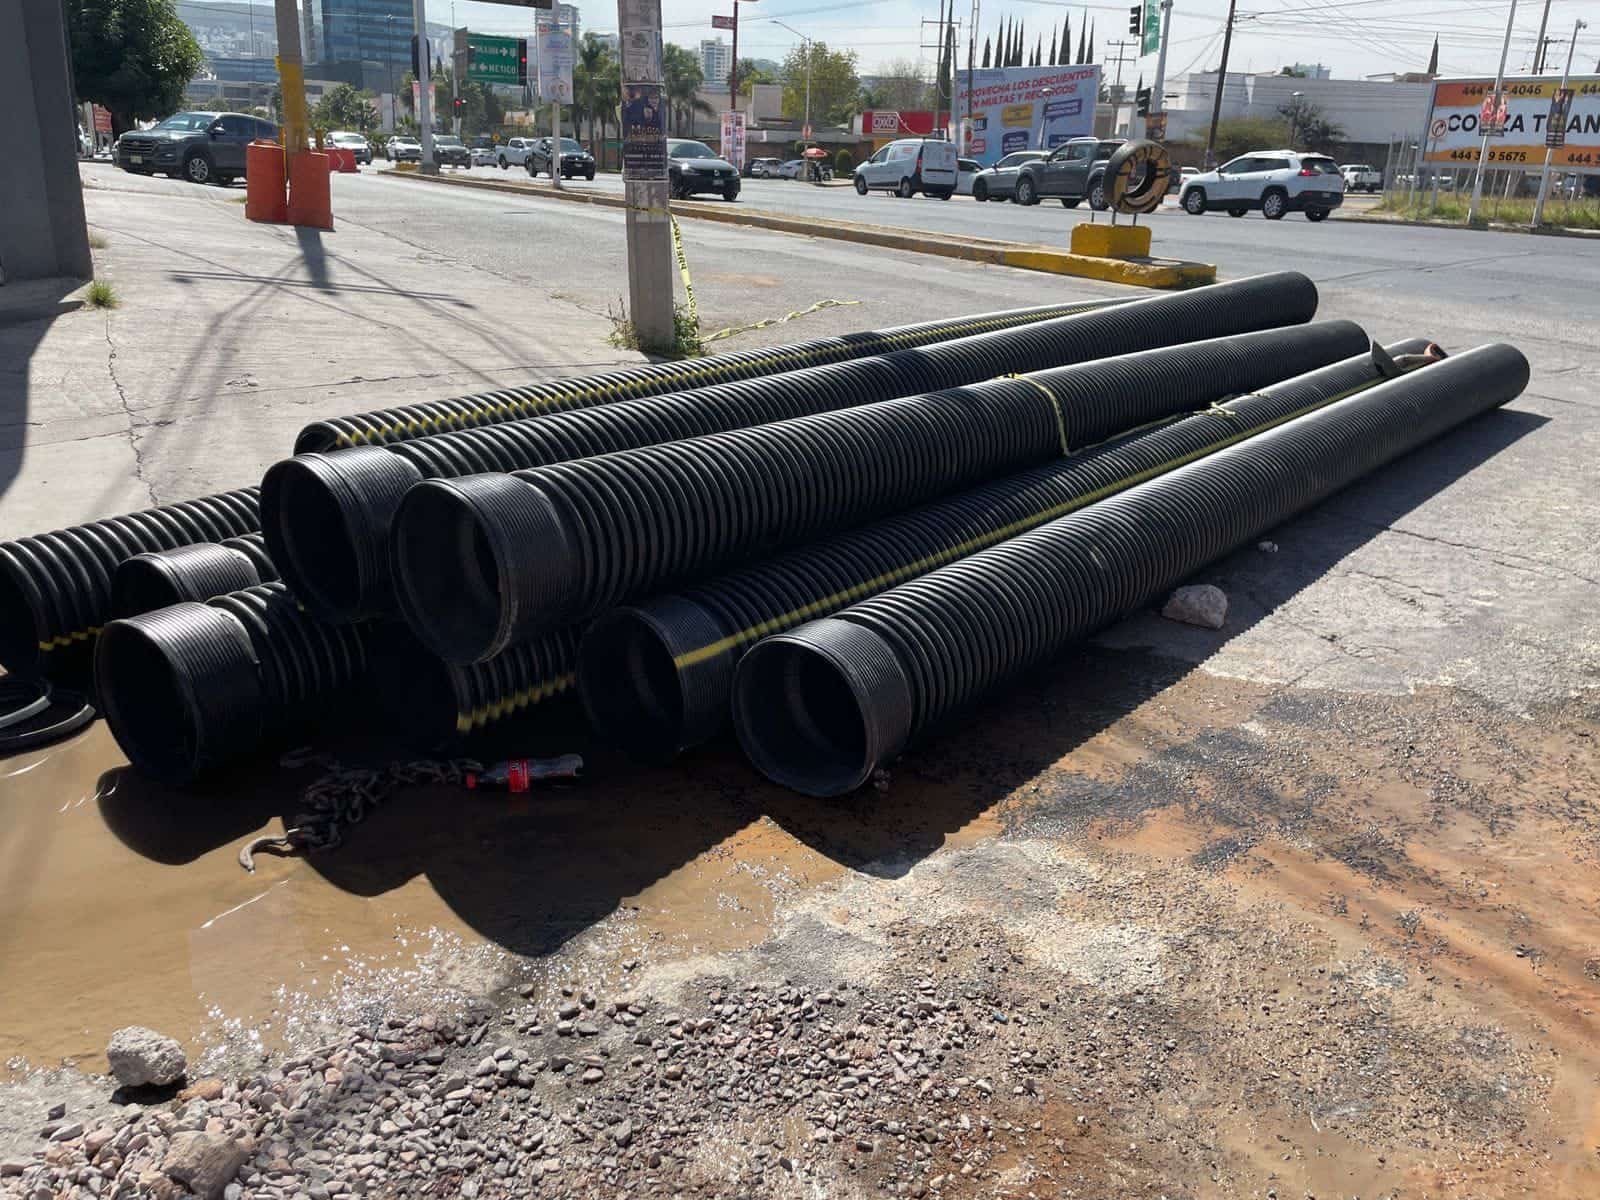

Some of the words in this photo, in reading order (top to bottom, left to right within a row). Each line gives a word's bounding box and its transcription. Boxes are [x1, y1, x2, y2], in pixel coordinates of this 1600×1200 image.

[1013, 80, 1029, 90] LOS
[1032, 70, 1095, 88] DESCUENTOS
[1463, 86, 1483, 95] 444
[1511, 85, 1542, 95] 4046
[980, 95, 1014, 107] MULTAS
[873, 116, 897, 129] OXXO
[1448, 114, 1525, 132] COZA
[1450, 150, 1471, 160] 444
[1474, 150, 1496, 161] 39
